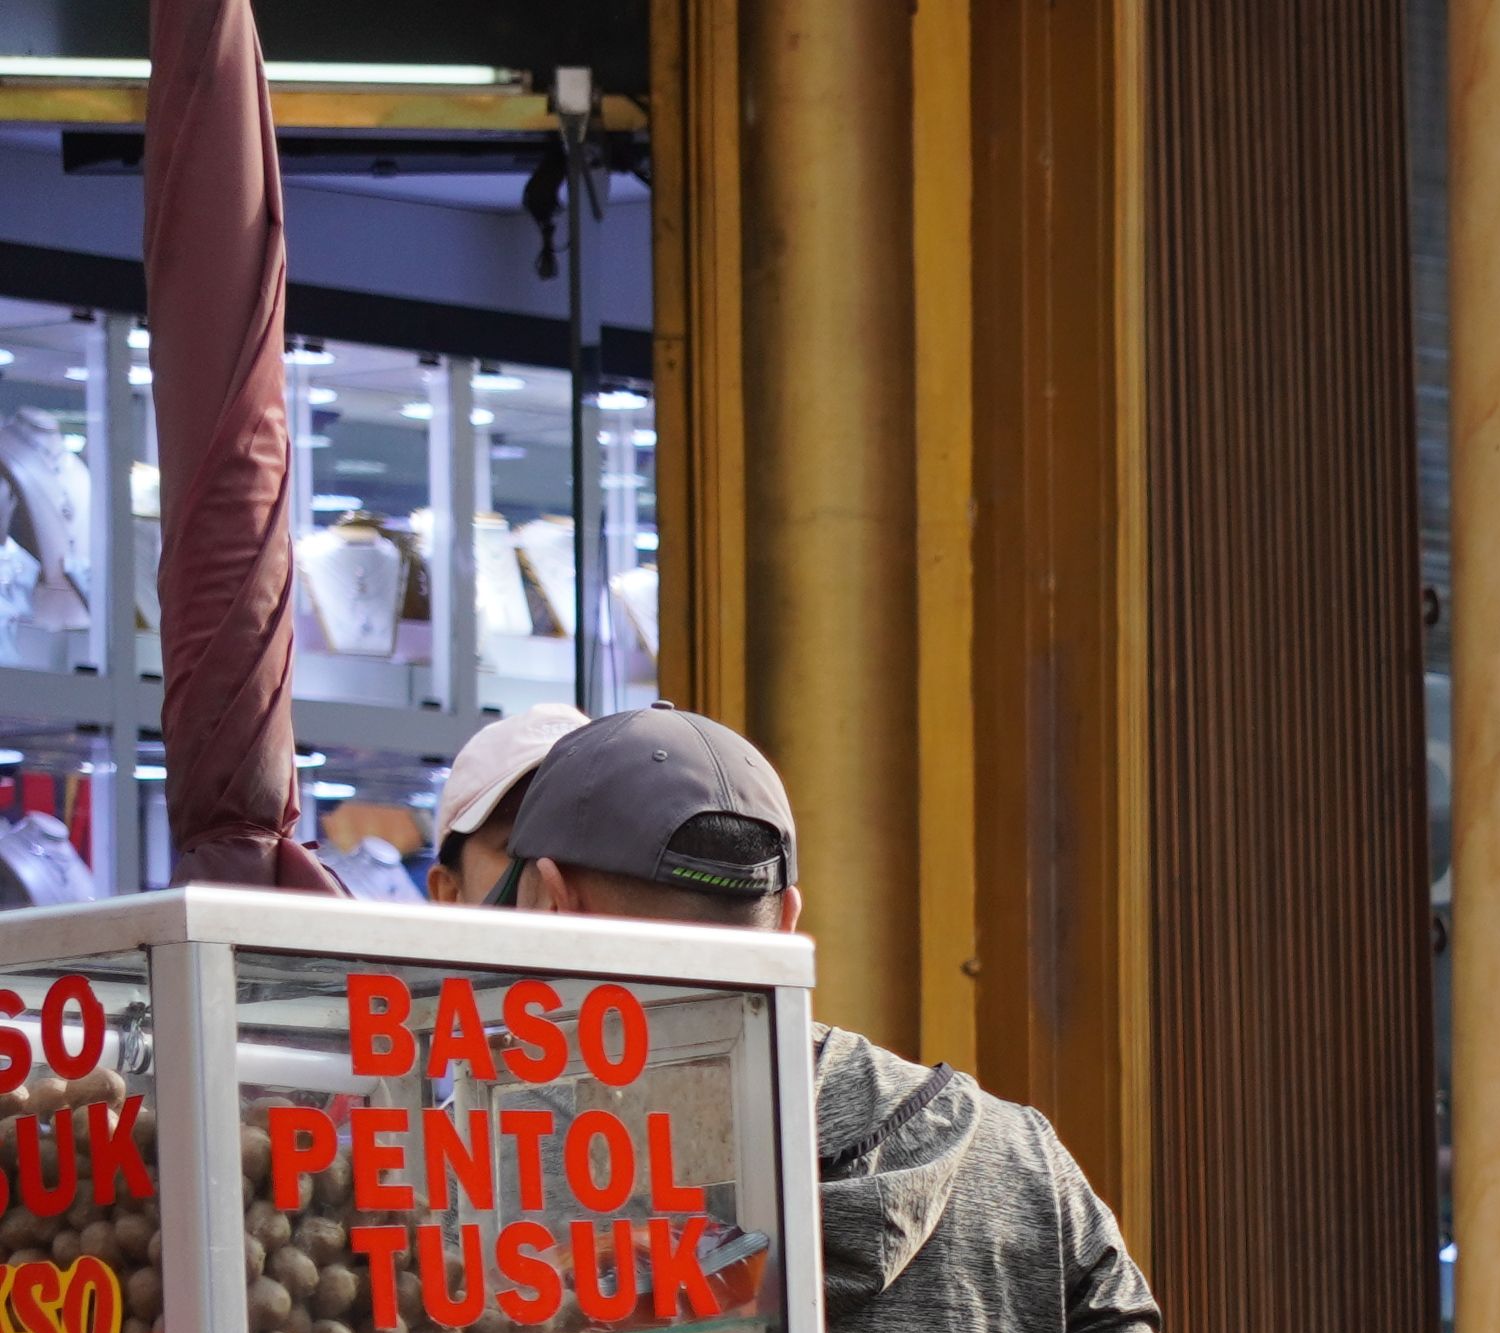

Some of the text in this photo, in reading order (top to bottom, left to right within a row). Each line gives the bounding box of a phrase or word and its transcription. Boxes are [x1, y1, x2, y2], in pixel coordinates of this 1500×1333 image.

[348, 973, 648, 1086] BASO
[0, 1094, 155, 1217] UK
[268, 1106, 705, 1213] PENTOL
[350, 1216, 721, 1330] TUSUK
